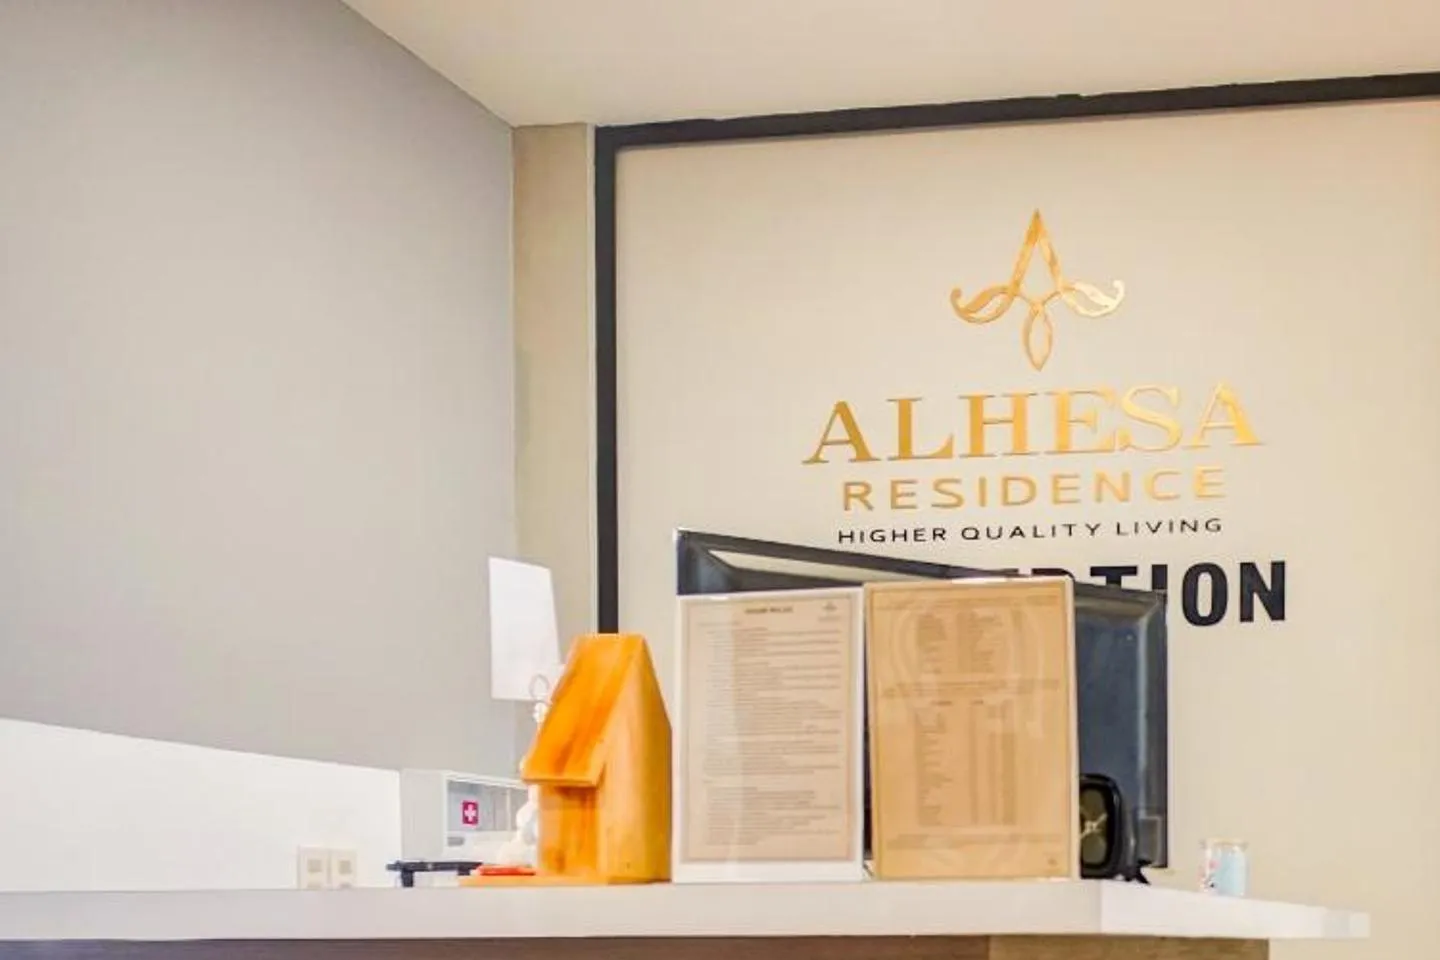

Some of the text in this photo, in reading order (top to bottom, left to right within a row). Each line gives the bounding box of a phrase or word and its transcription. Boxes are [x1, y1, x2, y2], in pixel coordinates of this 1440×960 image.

[803, 383, 1264, 464] ALHESA
[842, 464, 1227, 512] RESIDENCE
[838, 518, 1223, 544] HIGHER QUALITY LIVING
